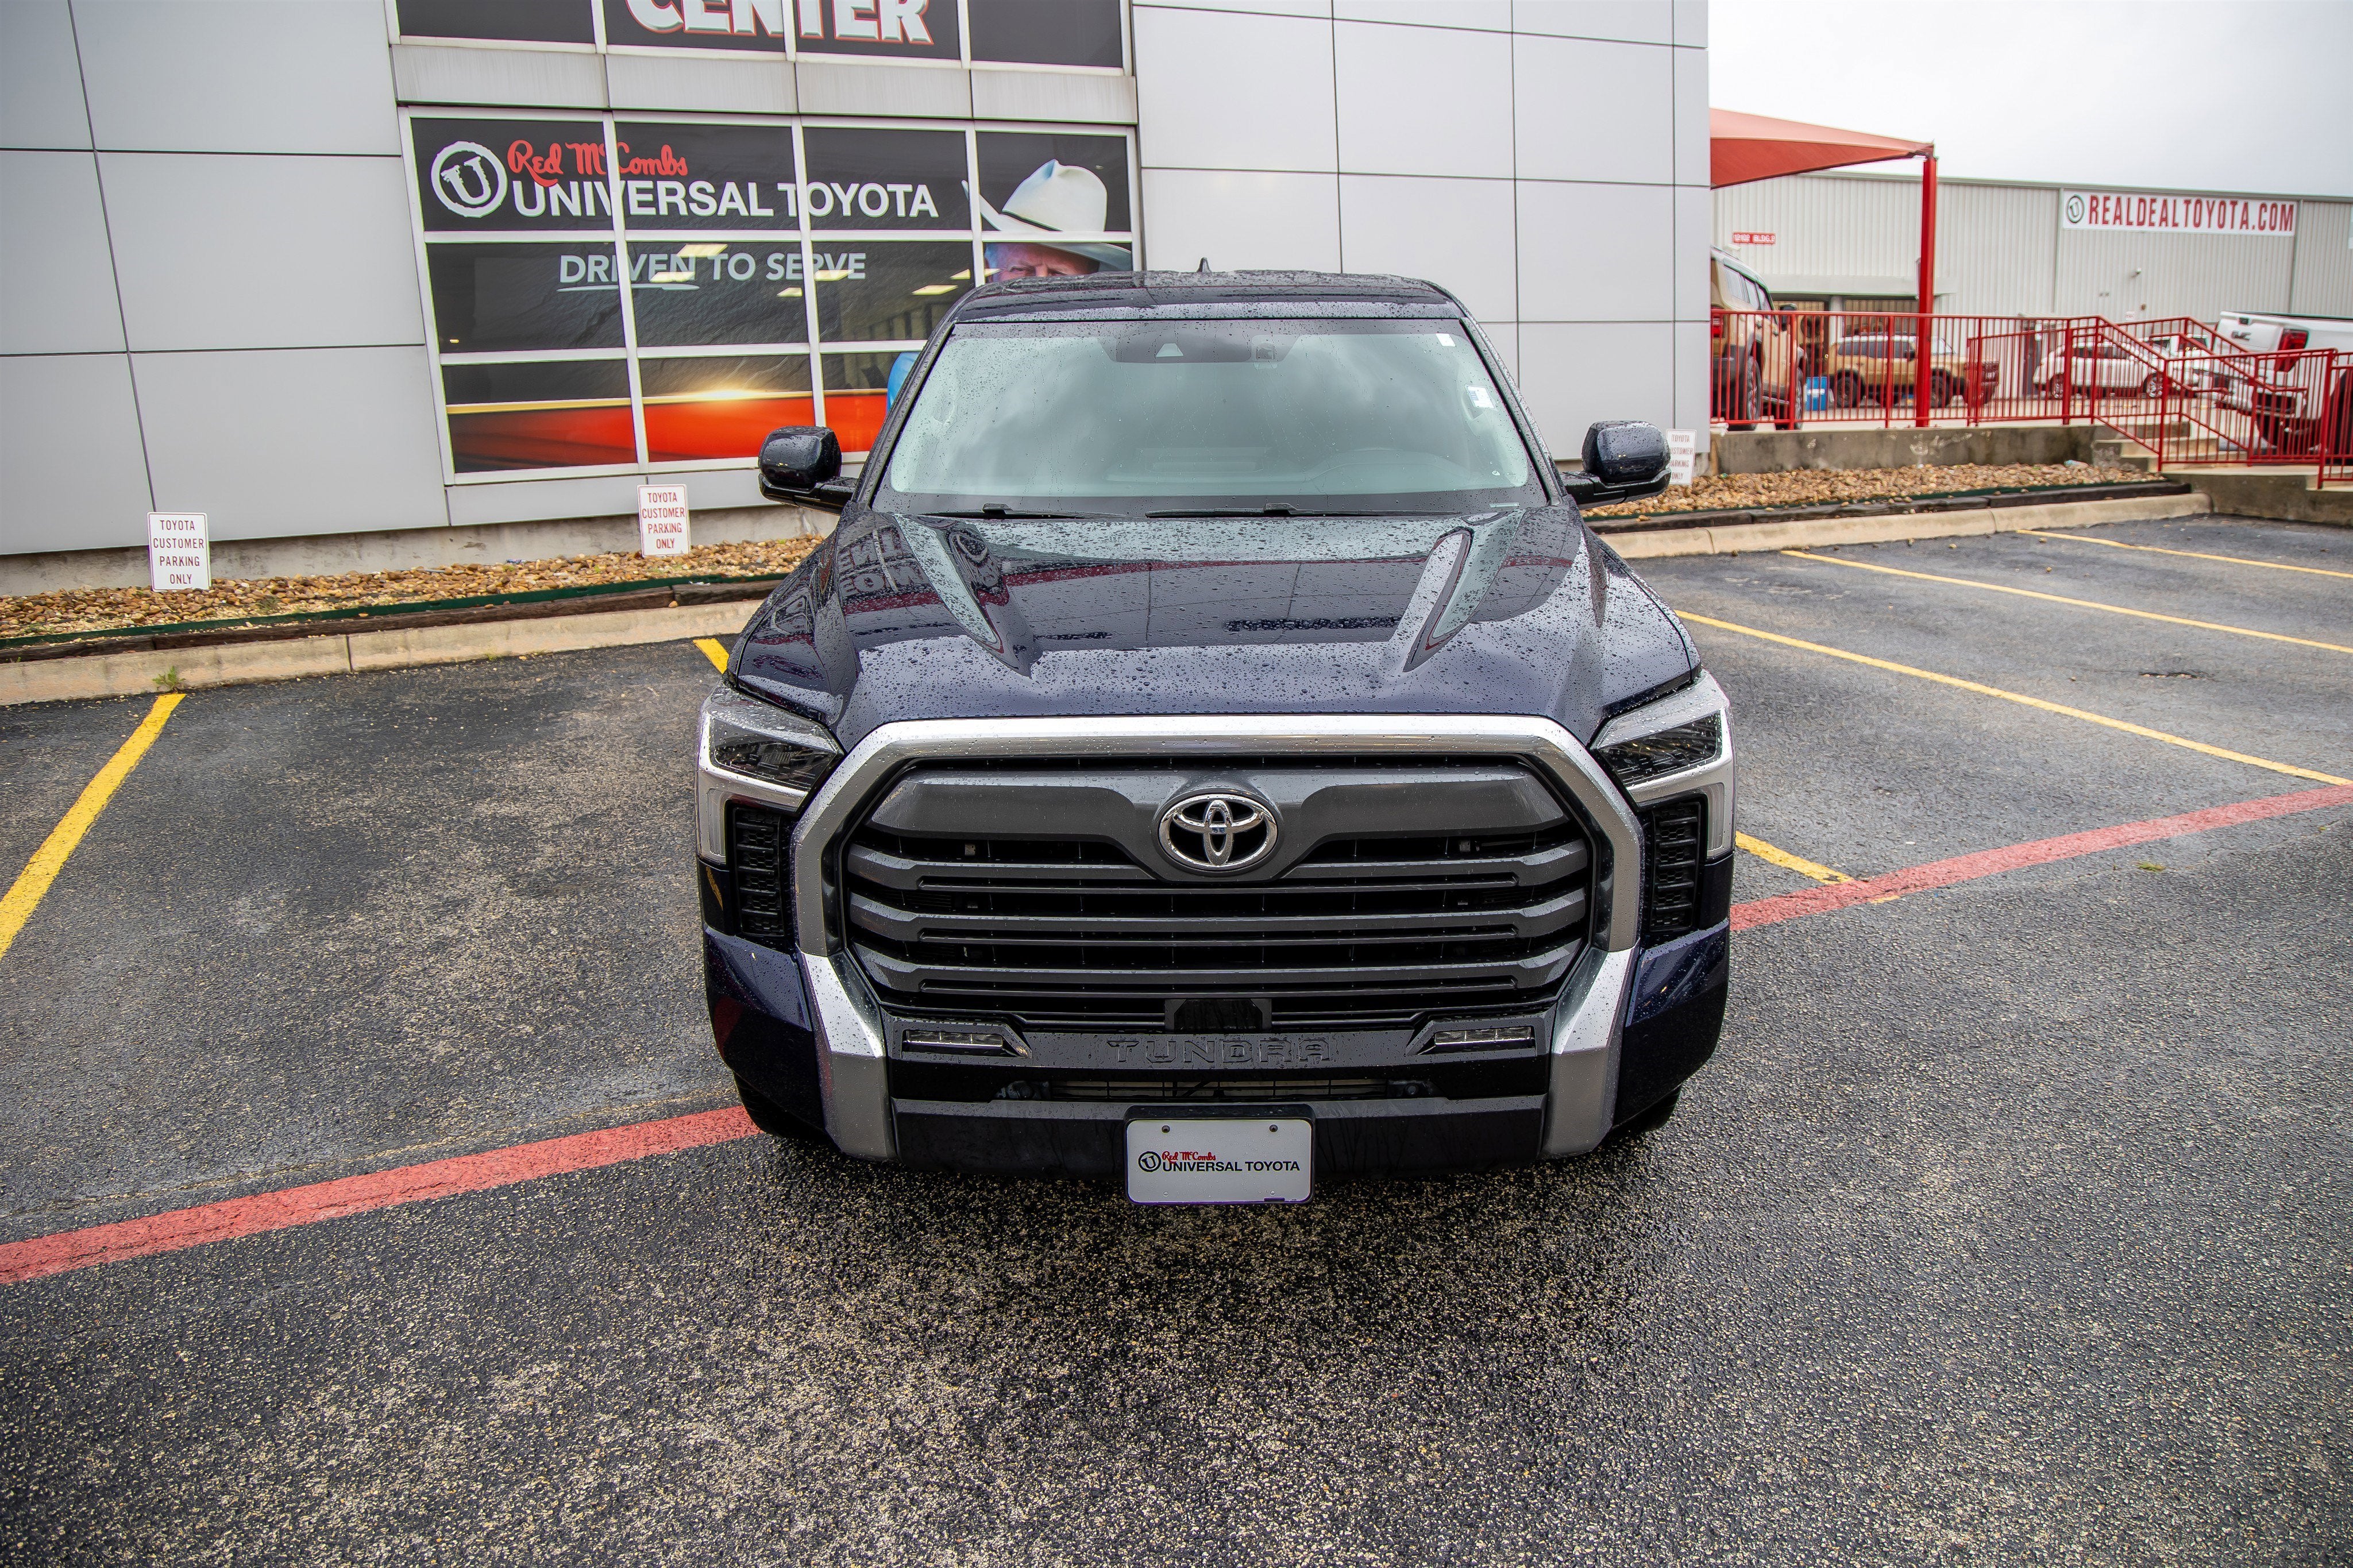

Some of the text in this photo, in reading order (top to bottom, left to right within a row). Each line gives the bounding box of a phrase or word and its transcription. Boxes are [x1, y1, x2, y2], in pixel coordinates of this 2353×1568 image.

[625, 0, 934, 44] CENTER
[507, 140, 561, 187] Red
[512, 180, 939, 218] UNIVERSAL TOYOTA
[2089, 195, 2293, 231] REALDEALTOYOTA.COM
[560, 254, 696, 284] DRIVEN
[707, 253, 755, 281] TO
[1671, 434, 1690, 442] TOYOTA
[1670, 447, 1694, 455] USTOMER
[1670, 459, 1689, 468] ARKING
[647, 492, 677, 503] TOYOTA
[642, 507, 685, 519] CUSTOMER
[160, 520, 195, 531] TOYOTA
[647, 523, 682, 534] PARKING
[153, 538, 205, 549] CUSTOMER
[656, 538, 675, 549] ONLY
[159, 556, 200, 566] PARKING
[169, 574, 192, 584] ONLY
[1106, 1038, 1332, 1064] TUNDRA
[1162, 1151, 1178, 1164] Red
[1163, 1161, 1300, 1172] UNIVERSAL TOYOTA
